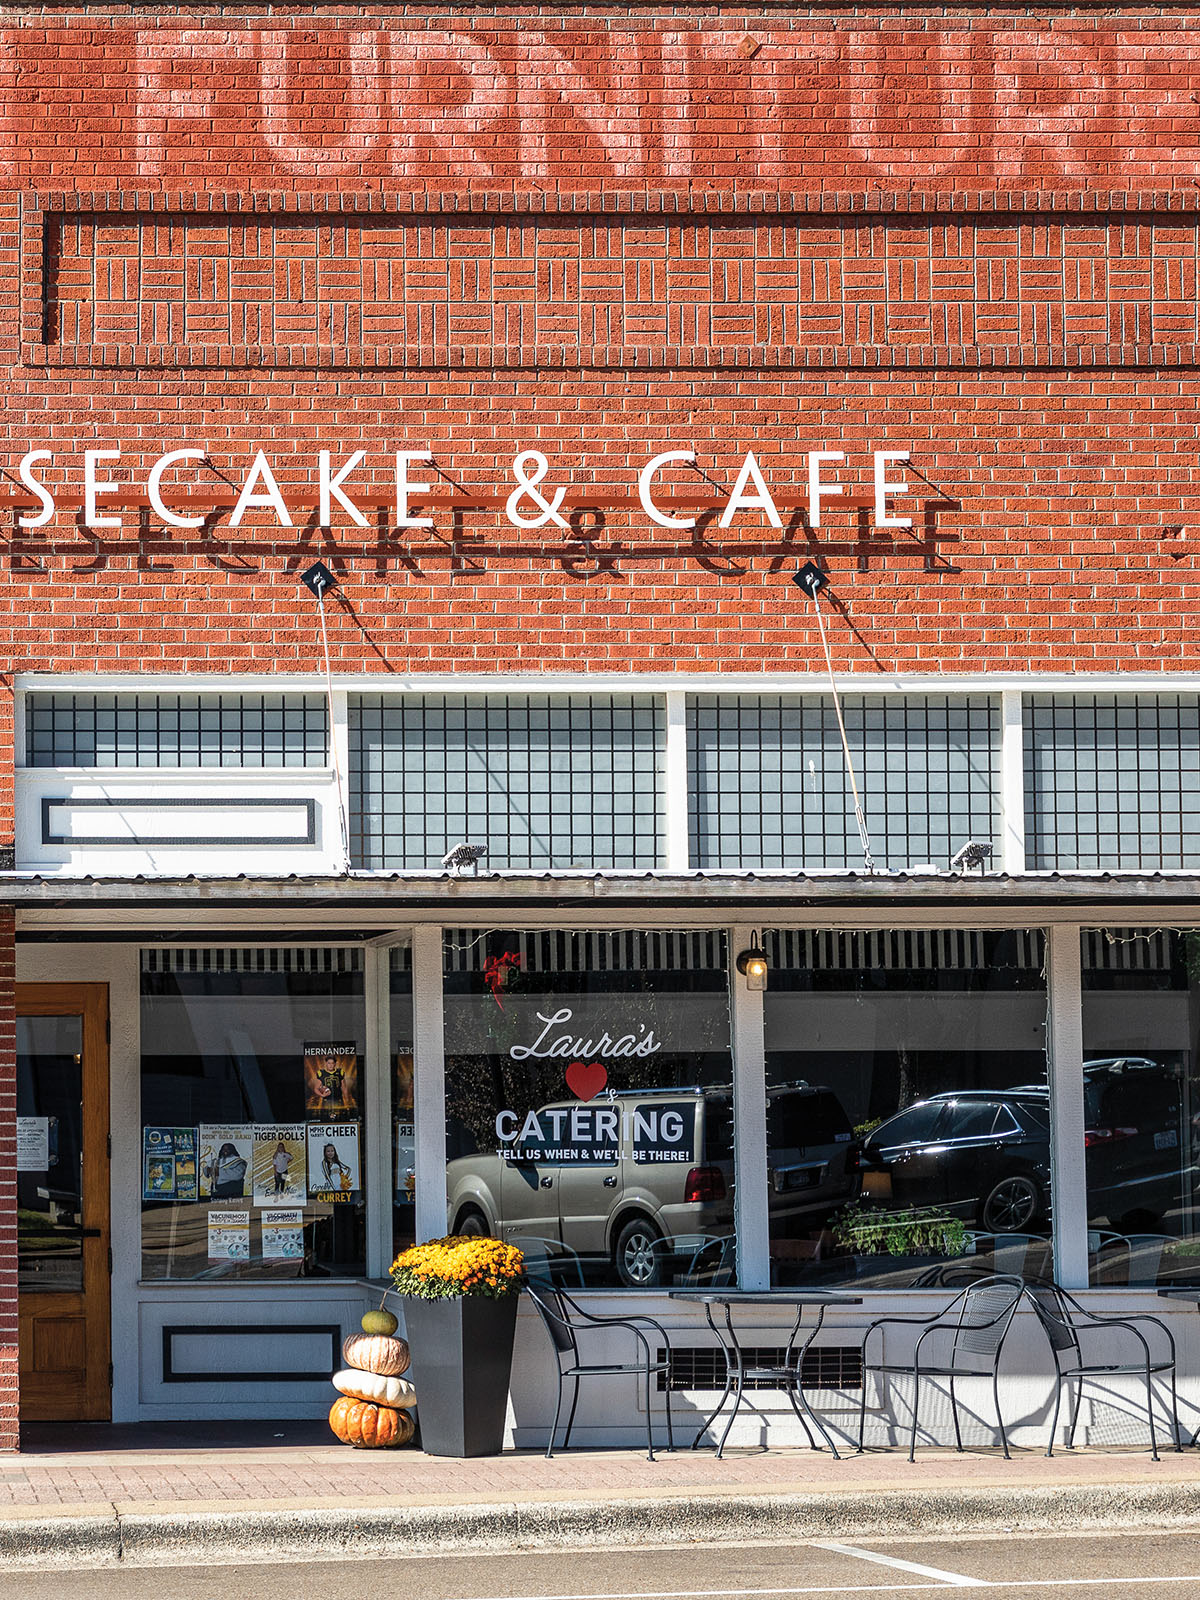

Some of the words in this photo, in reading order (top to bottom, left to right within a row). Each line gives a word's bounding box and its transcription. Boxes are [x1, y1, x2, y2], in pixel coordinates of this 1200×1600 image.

[134, 29, 1200, 180] FURNITURE
[505, 450, 570, 528] &
[638, 450, 912, 529] CAFE
[510, 1008, 661, 1060] Laura's
[304, 1047, 356, 1056] HERNANDEZ
[325, 1126, 356, 1137] CHEER
[495, 1110, 684, 1142] CATERING
[254, 1132, 276, 1141] TIGER
[277, 1132, 305, 1141] DOLLS
[496, 1149, 523, 1160] TELL
[526, 1149, 541, 1160] US
[544, 1149, 578, 1160] WHEN
[581, 1149, 590, 1160] &
[593, 1149, 628, 1160] WE'LL
[632, 1150, 646, 1161] BE
[648, 1150, 689, 1161] THERE!
[317, 1192, 352, 1202] CURREY
